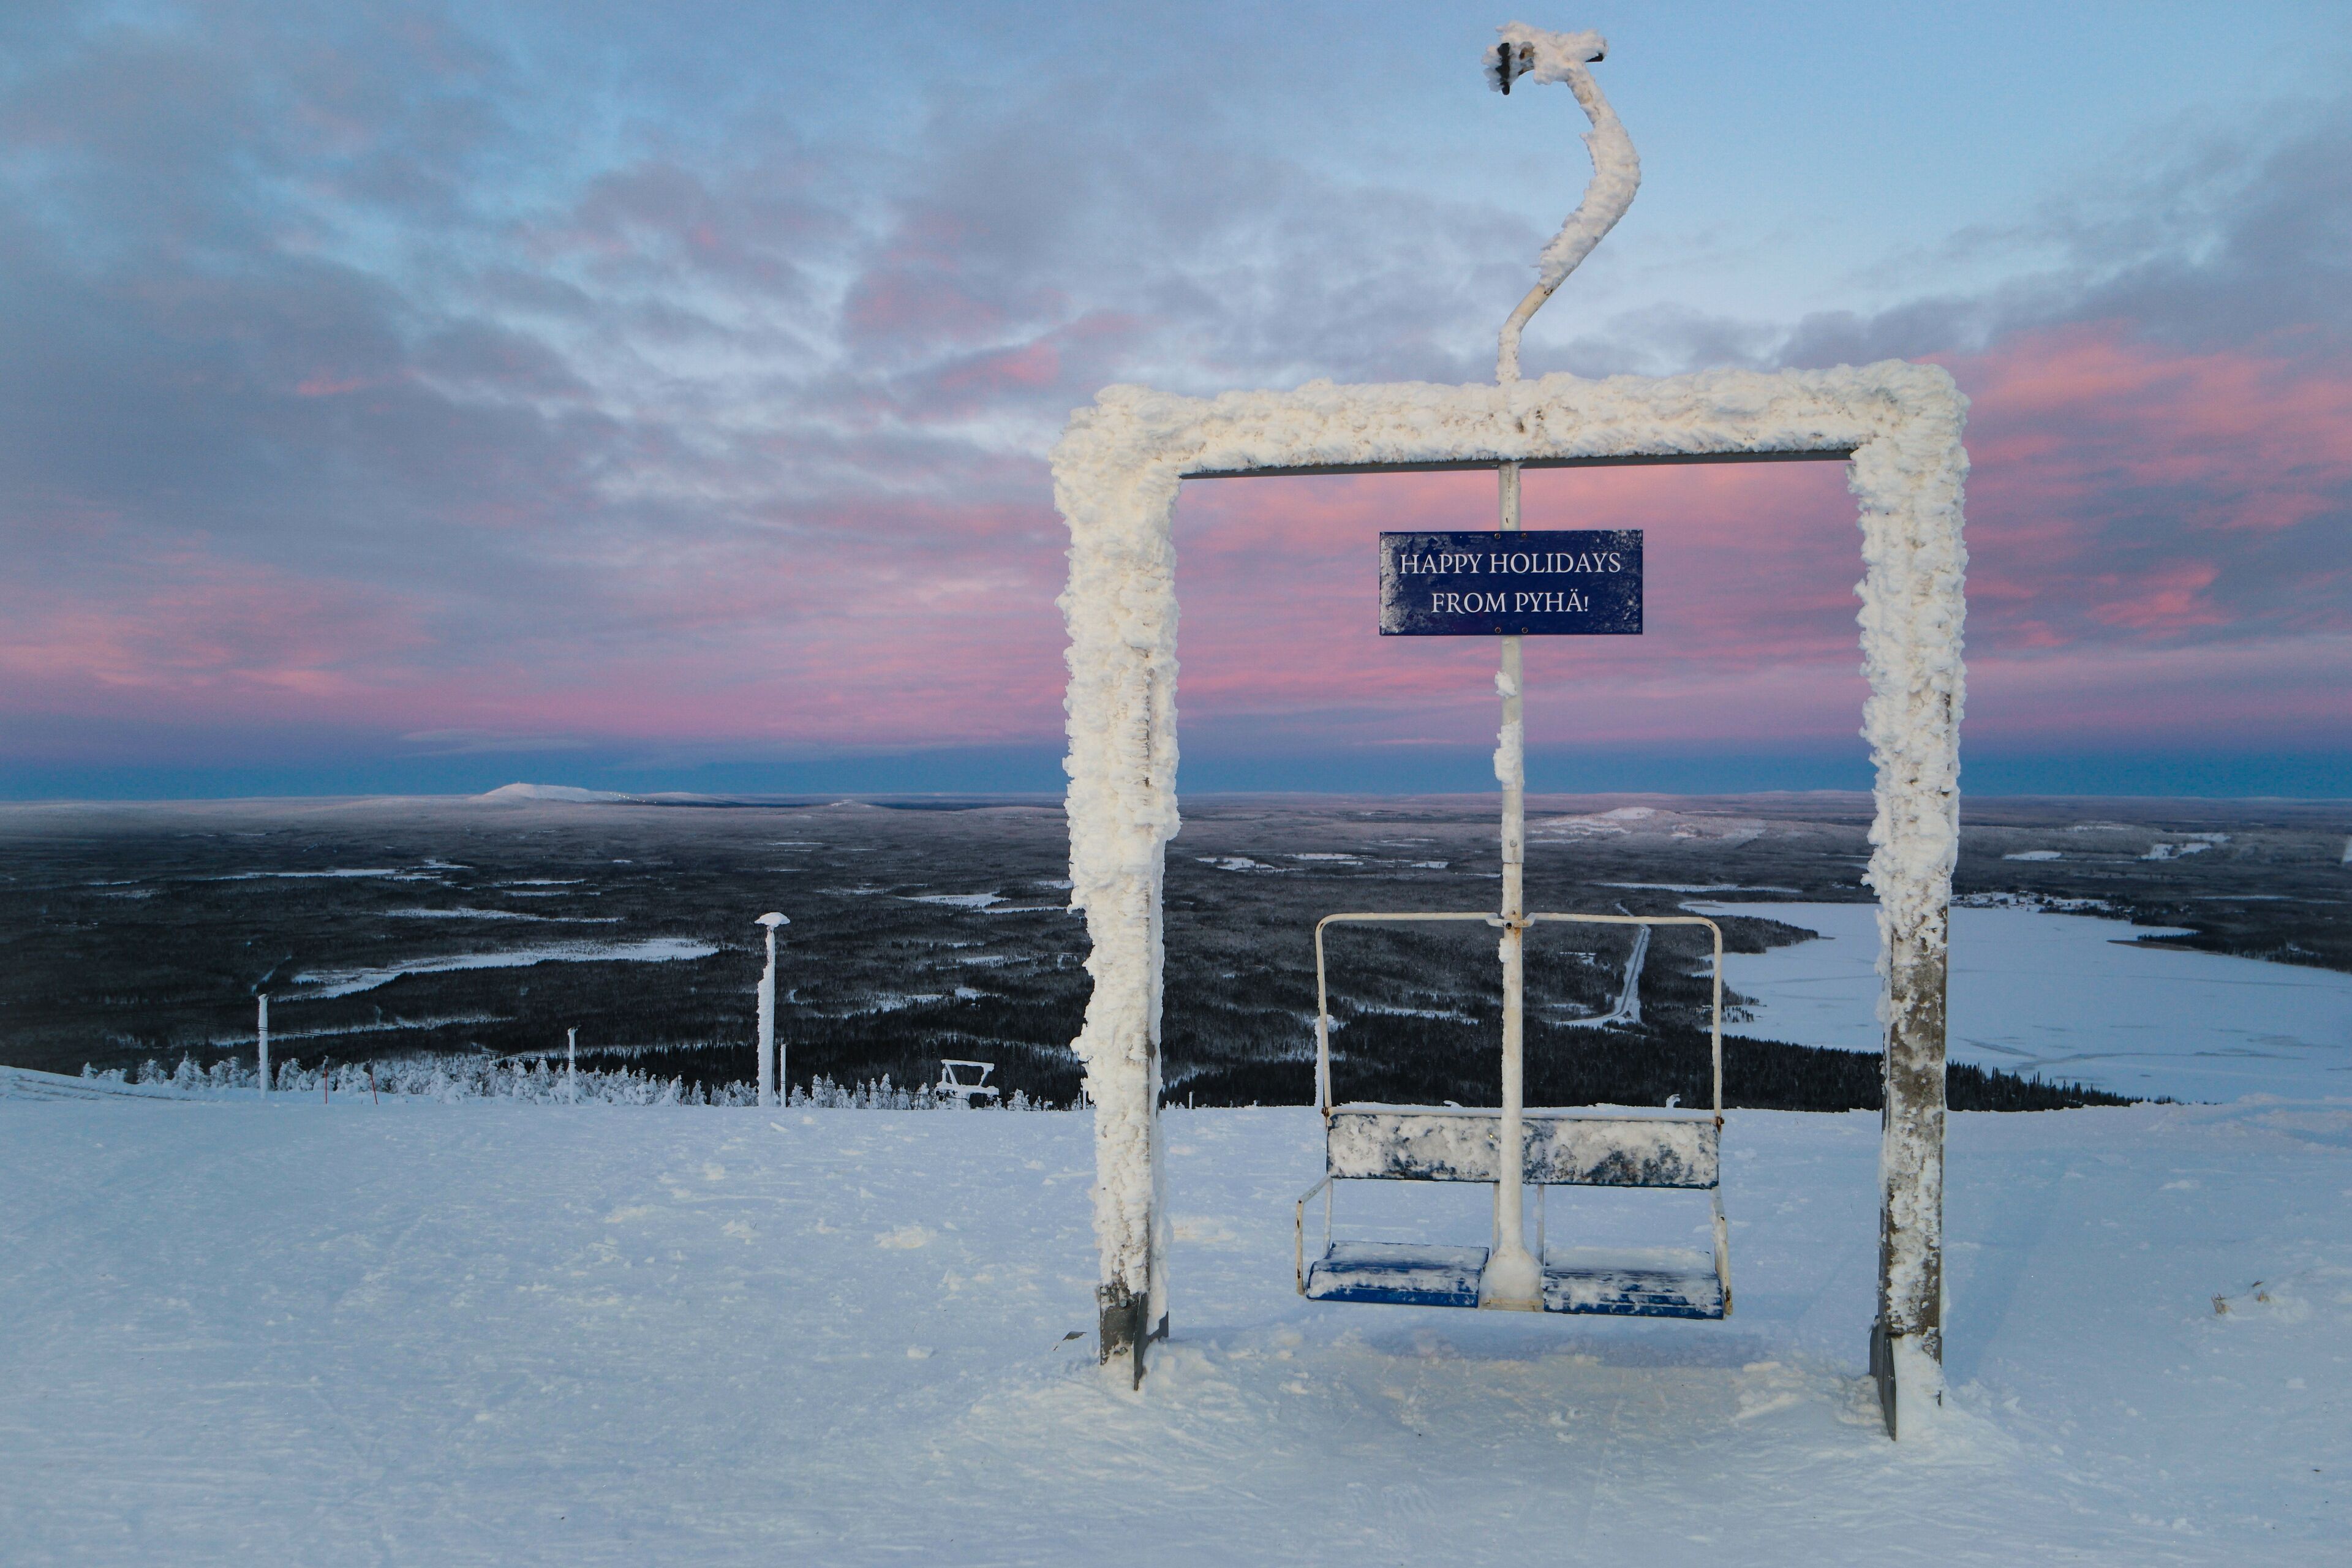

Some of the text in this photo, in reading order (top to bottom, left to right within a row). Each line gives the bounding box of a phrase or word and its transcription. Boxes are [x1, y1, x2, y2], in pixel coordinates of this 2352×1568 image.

[1400, 552, 1621, 575] HAPPY HOLIDAYS
[1431, 588, 1589, 615] FROM PYHÄ!
